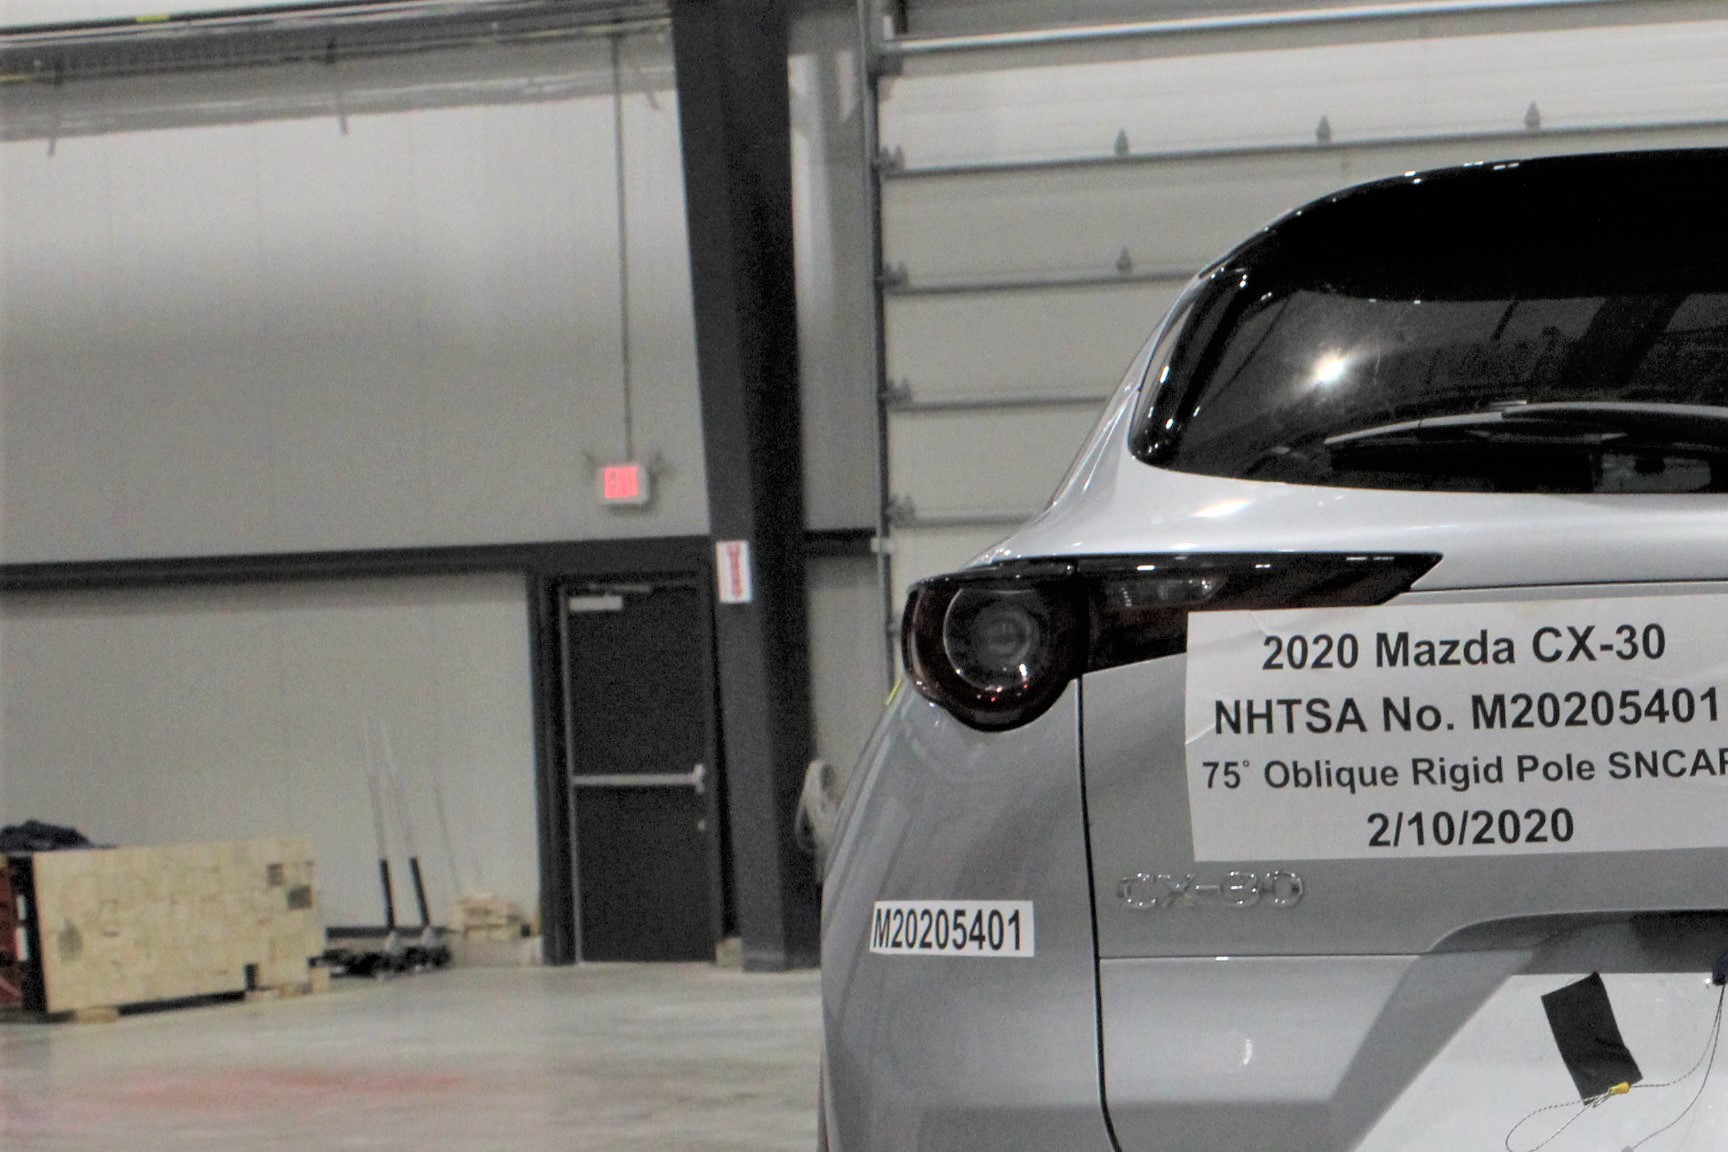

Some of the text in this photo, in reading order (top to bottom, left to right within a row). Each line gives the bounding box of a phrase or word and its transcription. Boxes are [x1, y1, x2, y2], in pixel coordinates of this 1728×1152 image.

[1261, 622, 1667, 671] 2020 Mazda CX-30
[1213, 687, 1719, 735] NHTSA No. M20205401
[1263, 757, 1399, 795] Oblique
[1411, 753, 1503, 792] Rigid
[1516, 748, 1596, 783] Pole
[1366, 807, 1575, 848] 2/10/2020
[873, 908, 1022, 951] M20205401
